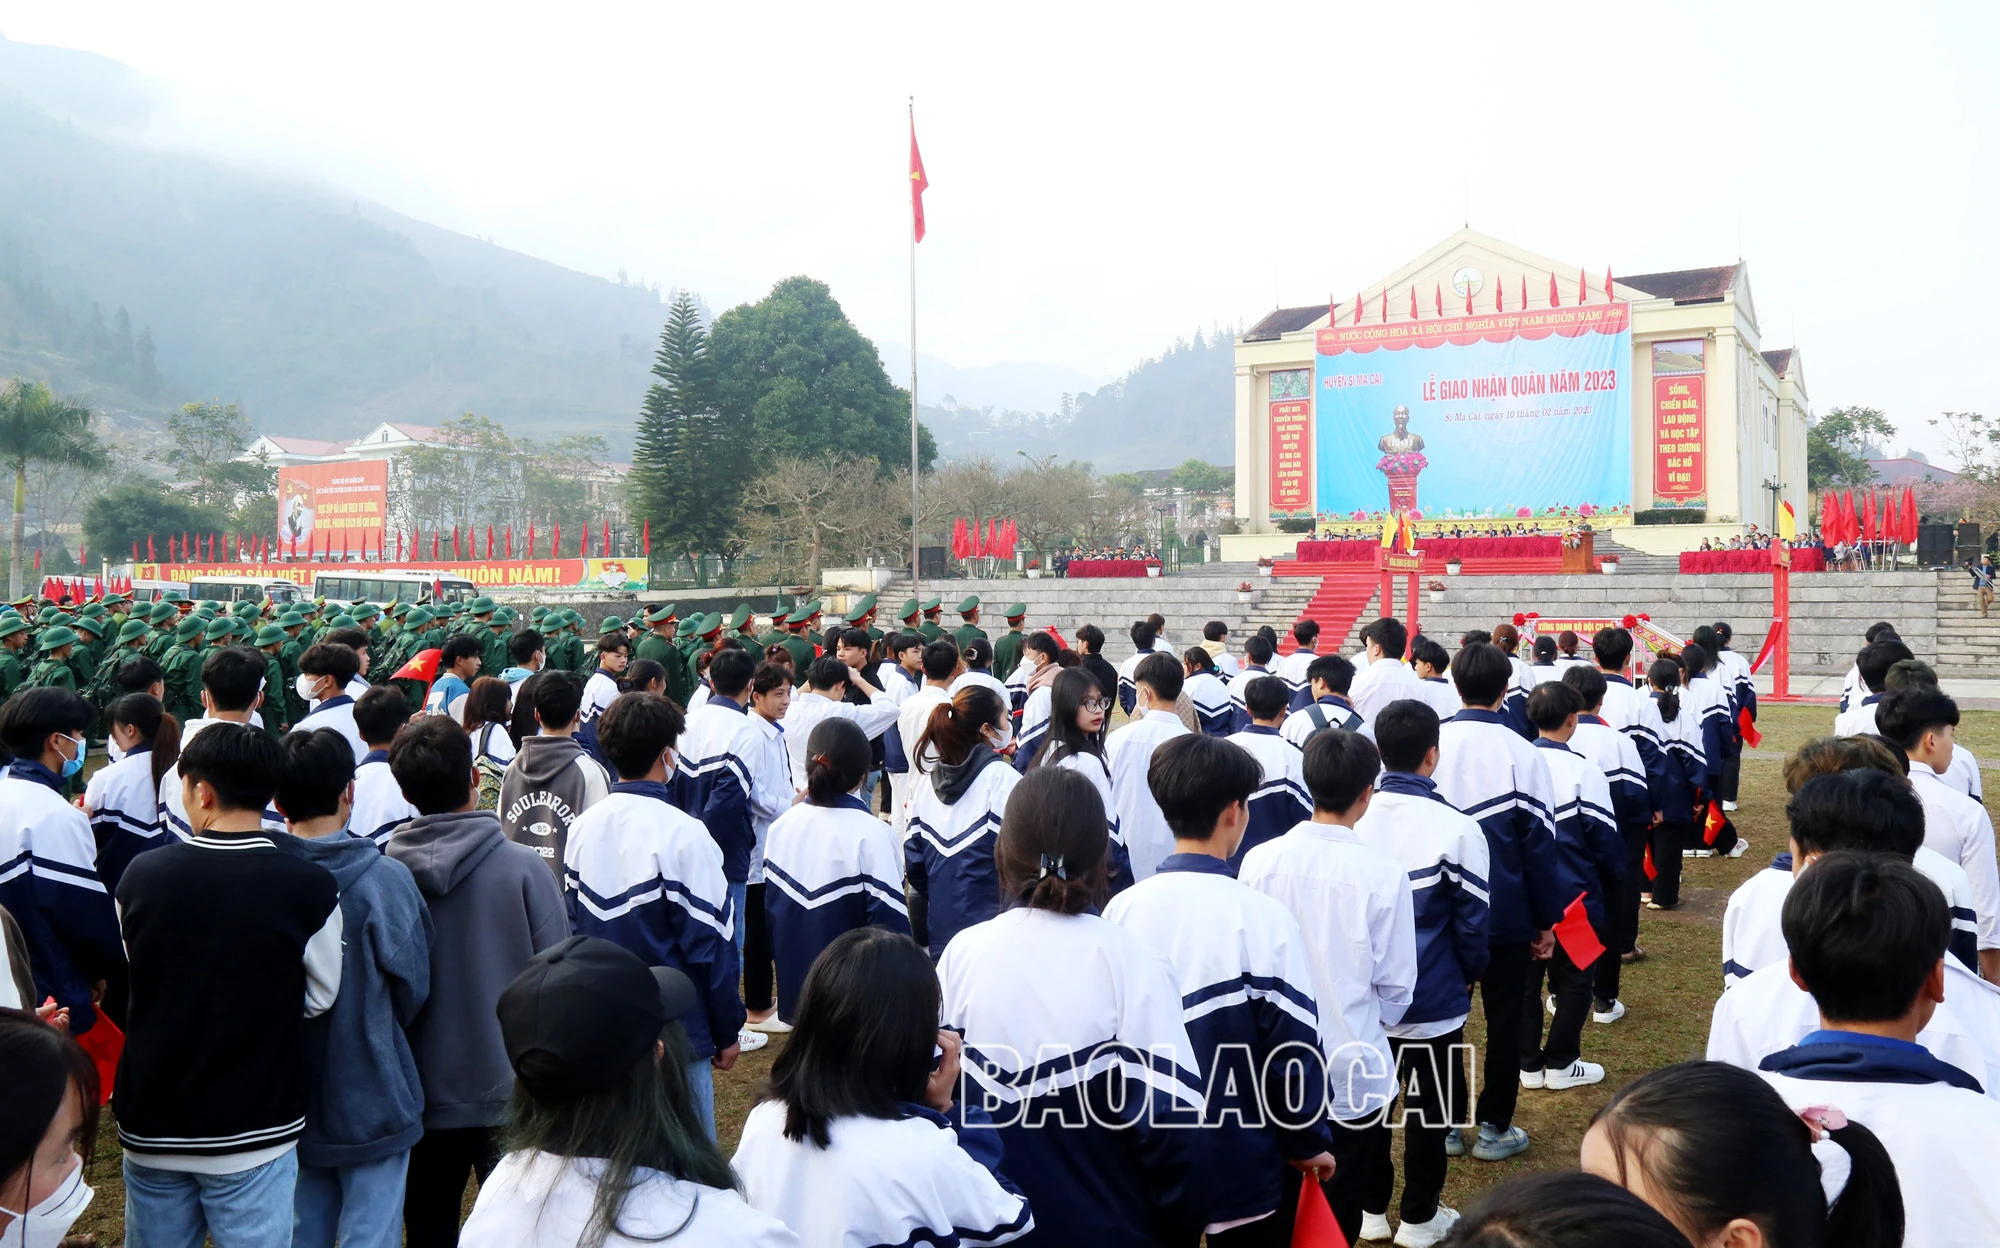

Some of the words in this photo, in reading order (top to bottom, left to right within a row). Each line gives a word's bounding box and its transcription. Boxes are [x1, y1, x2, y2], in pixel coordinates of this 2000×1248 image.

[1339, 329, 1362, 341] NƯỚC
[1364, 327, 1388, 339] CỘNG
[1445, 319, 1463, 332] CHỦ
[1498, 314, 1520, 329] VIỆT
[1522, 315, 1544, 326] NAM
[1546, 310, 1575, 323] MUÔN
[1422, 372, 1436, 402] LỄ
[1439, 378, 1468, 401] GIAO
[1472, 372, 1507, 402] NHẬN
[1511, 370, 1546, 398] QUÂN
[1550, 367, 1581, 393] NĂM
[1584, 369, 1617, 392] 2023
[1506, 410, 1515, 419] 10
[1542, 407, 1552, 417] 02
[1572, 405, 1593, 415] 2023
[508, 564, 561, 584] NĂM!
[530, 846, 555, 858] 022
